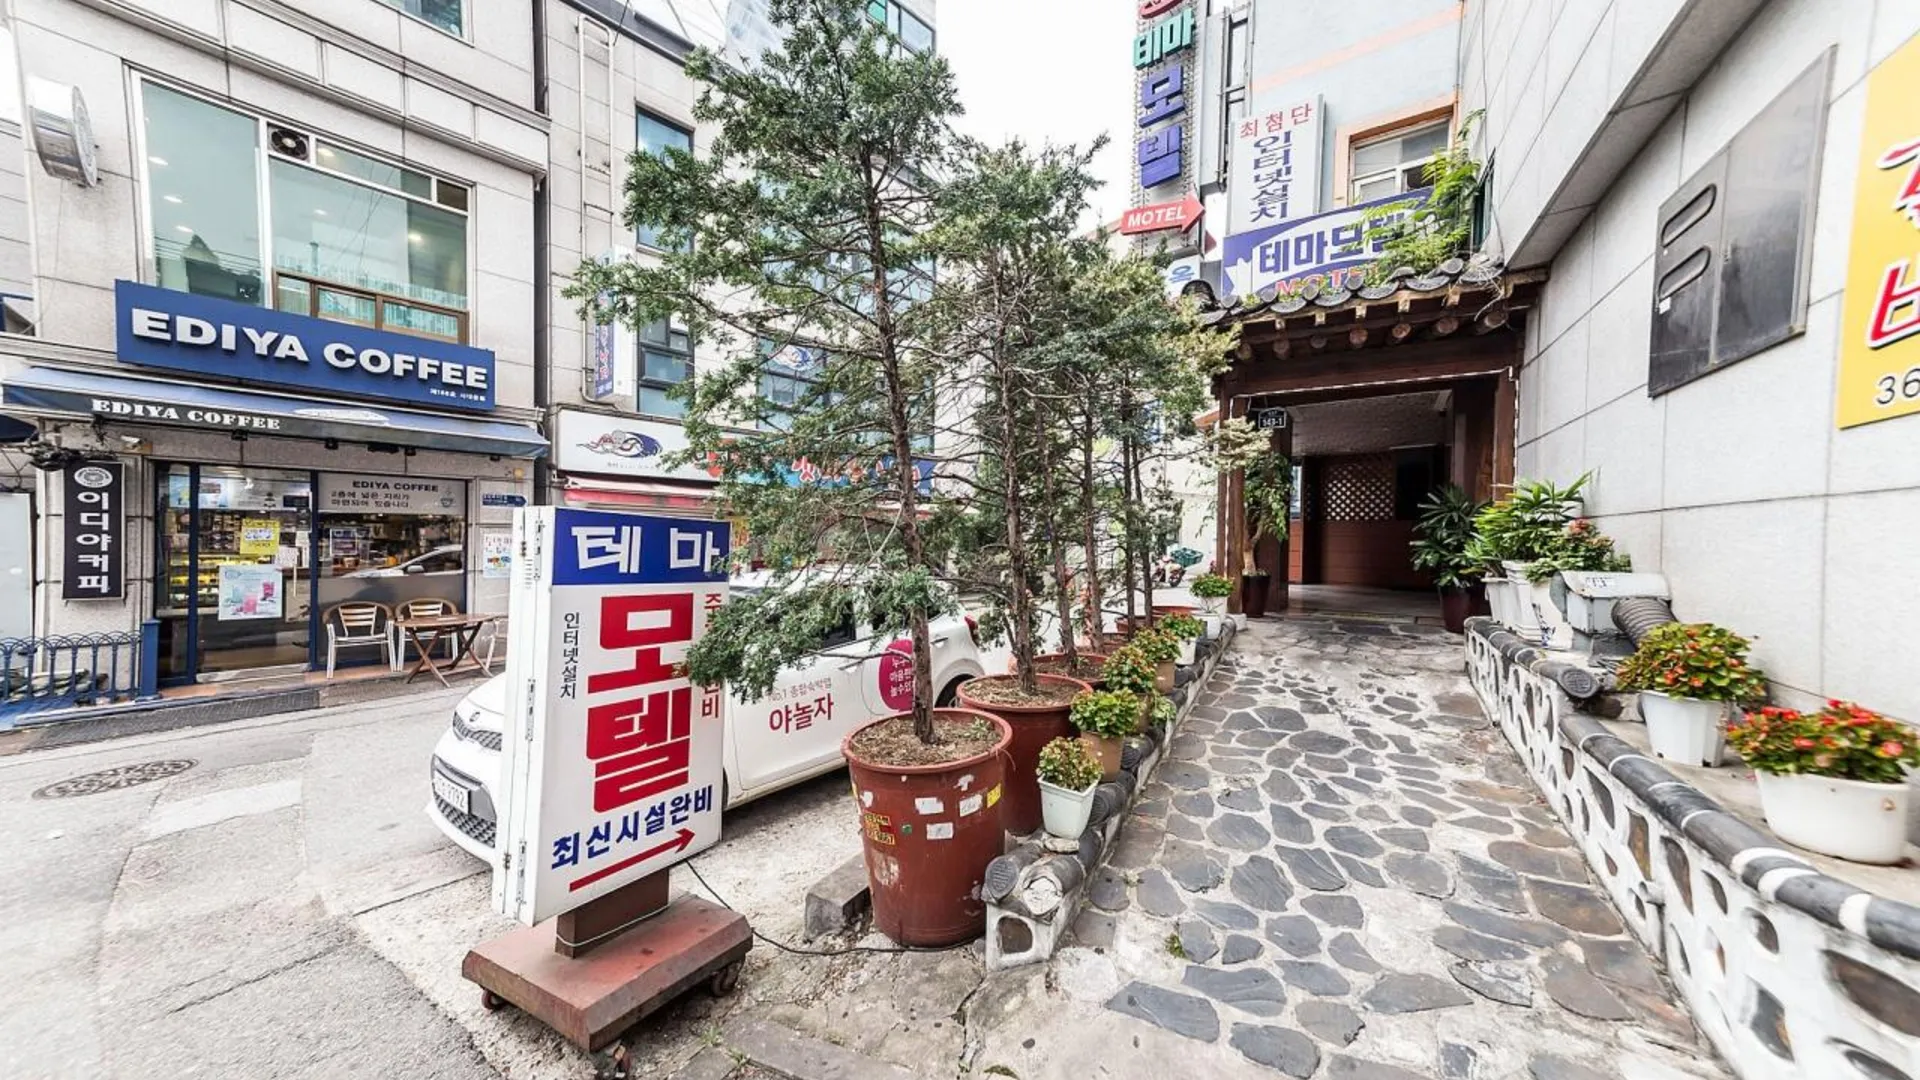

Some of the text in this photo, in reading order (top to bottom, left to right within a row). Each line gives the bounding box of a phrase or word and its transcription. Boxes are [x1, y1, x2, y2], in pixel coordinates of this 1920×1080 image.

[1133, 8, 1195, 70] 테마
[1138, 64, 1185, 189] 모텔
[1240, 103, 1312, 139] 최첨단
[1250, 131, 1292, 222] 인터넷설치
[1128, 206, 1186, 228] MOTEL
[131, 307, 488, 389] EDIYA COFFEE
[91, 399, 281, 430] EDIYA COFFEE
[353, 481, 439, 492] EDIYA COFFEE
[76, 491, 112, 593] 이디야커피
[571, 526, 720, 574] 테마
[560, 612, 580, 699] 인터넷설치
[586, 592, 694, 813] 모텔
[769, 693, 834, 733] 야놀자
[551, 785, 713, 870] 최신시설완비
